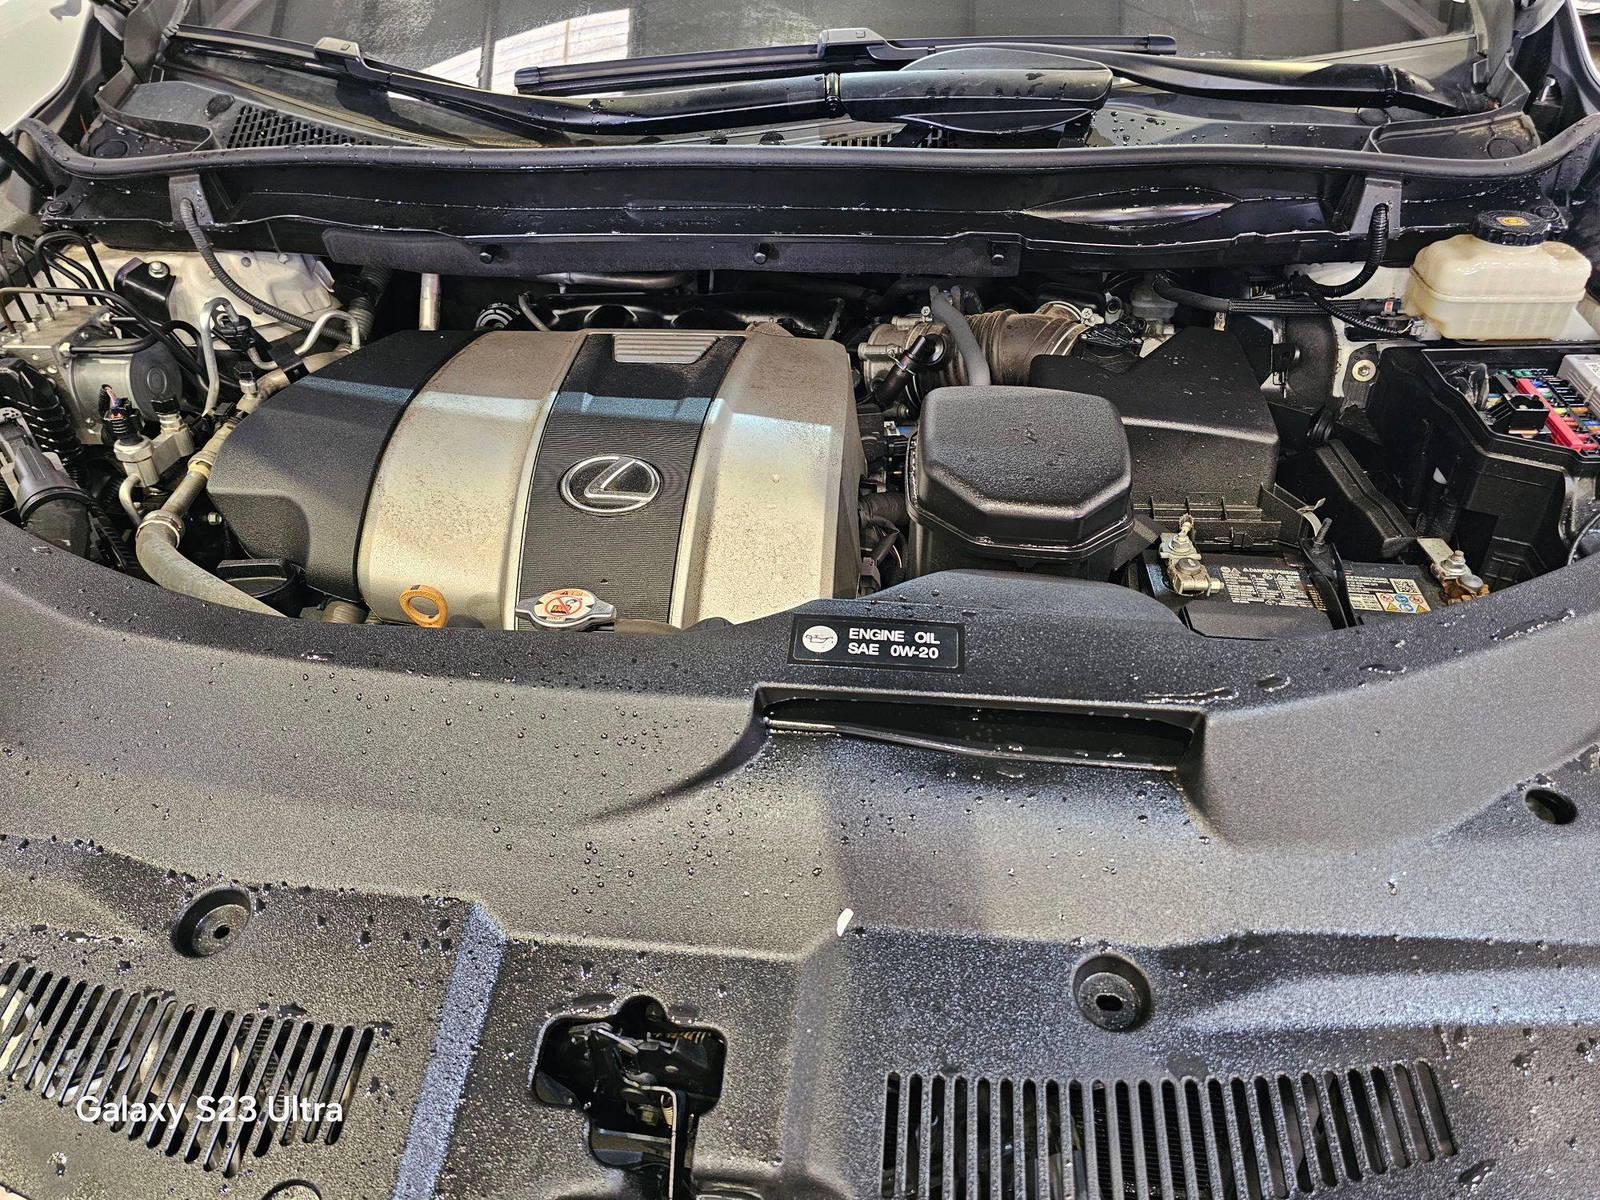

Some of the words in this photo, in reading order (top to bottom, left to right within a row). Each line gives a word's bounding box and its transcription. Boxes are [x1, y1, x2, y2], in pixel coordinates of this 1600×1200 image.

[849, 628, 905, 642] ENGINE
[914, 631, 940, 644] OIL
[847, 642, 880, 656] SAE
[890, 645, 939, 659] 0W-20
